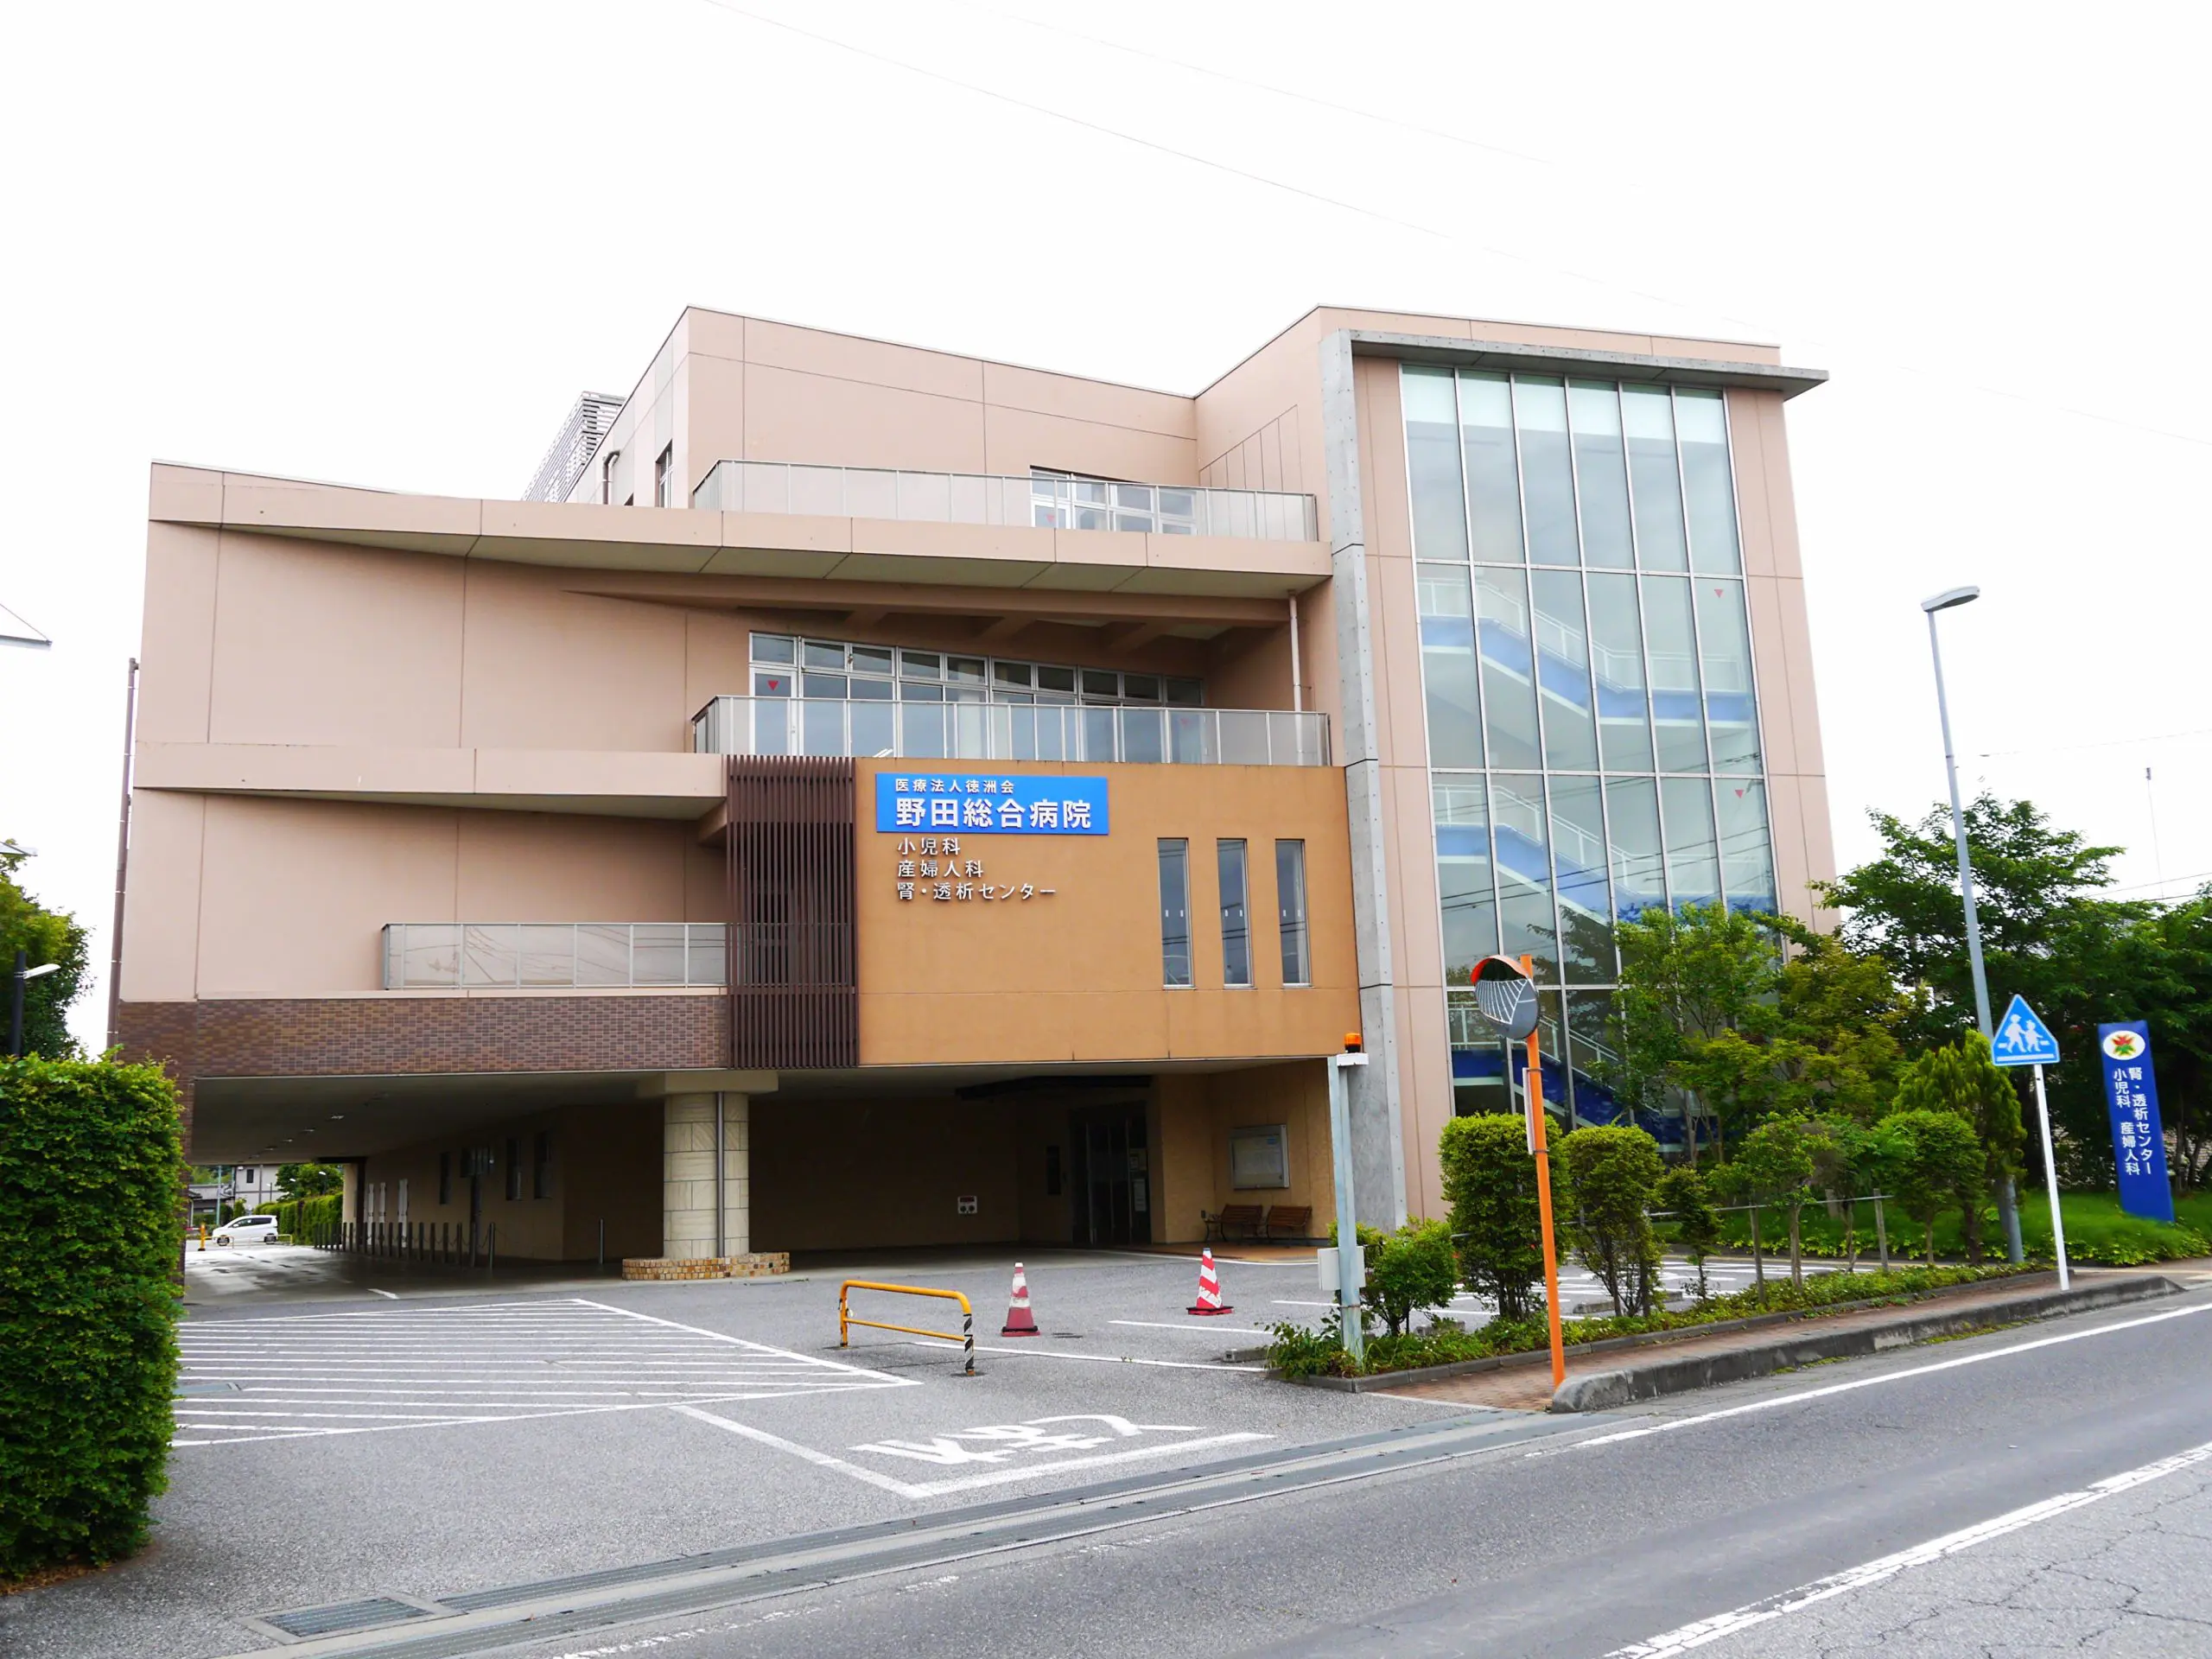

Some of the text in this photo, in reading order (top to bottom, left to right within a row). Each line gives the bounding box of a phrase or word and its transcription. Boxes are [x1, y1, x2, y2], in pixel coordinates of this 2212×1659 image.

[896, 798, 1091, 829] 野田総合病院
[897, 837, 961, 855] 小児科
[898, 860, 984, 878] 産婦人科
[897, 882, 1057, 900] 腎・透析センター
[2113, 1068, 2140, 1175] 小児科 産婦人科
[2128, 1067, 2153, 1175] 腎・透析センター
